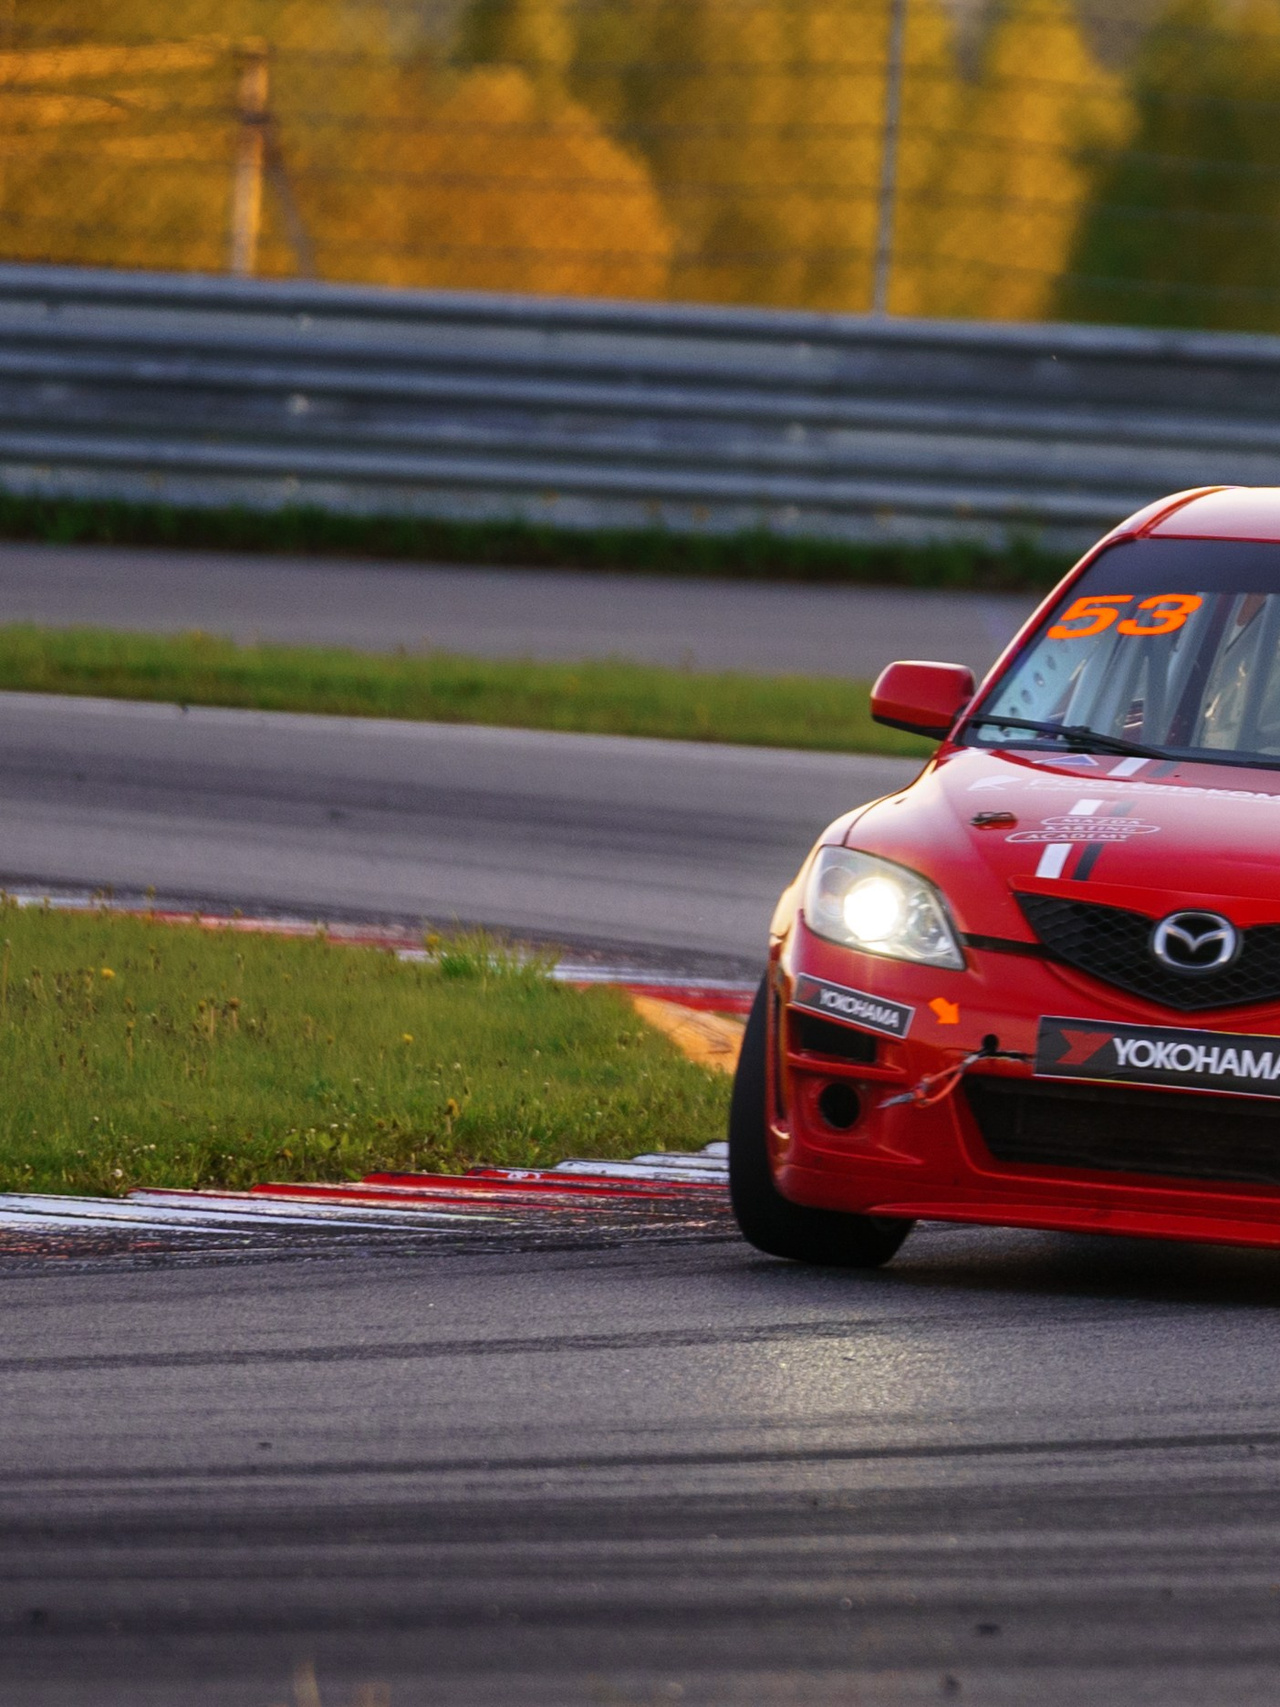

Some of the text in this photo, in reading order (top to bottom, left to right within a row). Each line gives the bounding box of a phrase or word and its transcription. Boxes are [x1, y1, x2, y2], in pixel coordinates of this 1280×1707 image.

[1046, 593, 1203, 640] 53
[1044, 825, 1138, 833] KARTING
[820, 988, 900, 1028] YOKOHAMA
